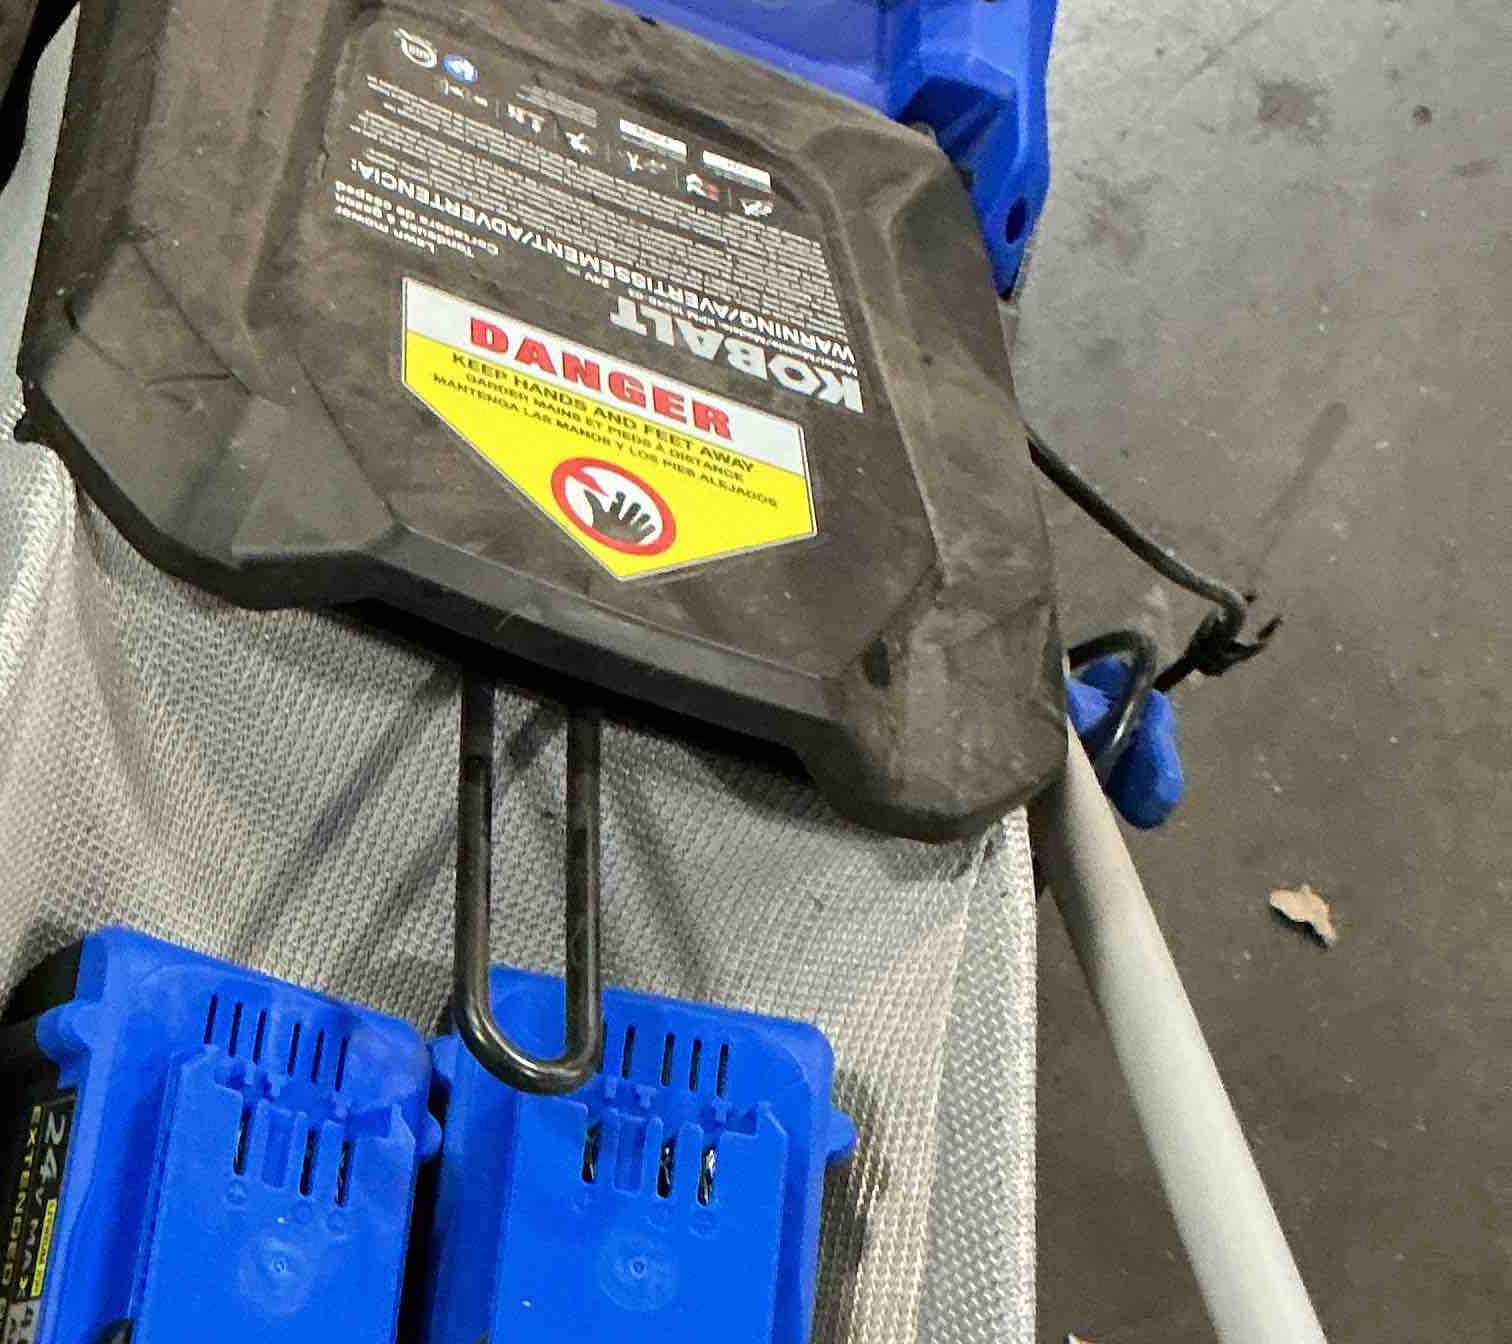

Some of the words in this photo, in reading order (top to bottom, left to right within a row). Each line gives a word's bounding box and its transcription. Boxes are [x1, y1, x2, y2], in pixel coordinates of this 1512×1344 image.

[351, 157, 857, 365] WARNING/AVERTISSEMENT/ADVERTENCIA:
[394, 228, 438, 254] Lawn
[452, 351, 508, 382] KEEP
[514, 374, 587, 412] HANDS
[594, 406, 637, 431] AND
[643, 423, 692, 451] FEET
[700, 446, 755, 473] AWAY
[470, 316, 733, 441] DANGER
[609, 295, 864, 414] KOBALT
[433, 373, 519, 413] MANTENGA
[523, 407, 553, 426] LAS
[556, 420, 611, 446] MANOS
[628, 444, 659, 466] LOS
[662, 458, 697, 479] PIES
[699, 474, 778, 509] ALEJADOS
[607, 426, 652, 449] PIEDS
[669, 446, 744, 481] DISTANCE
[1, 1105, 42, 1286] EXTENDED
[17, 1218, 40, 1299] MAX
